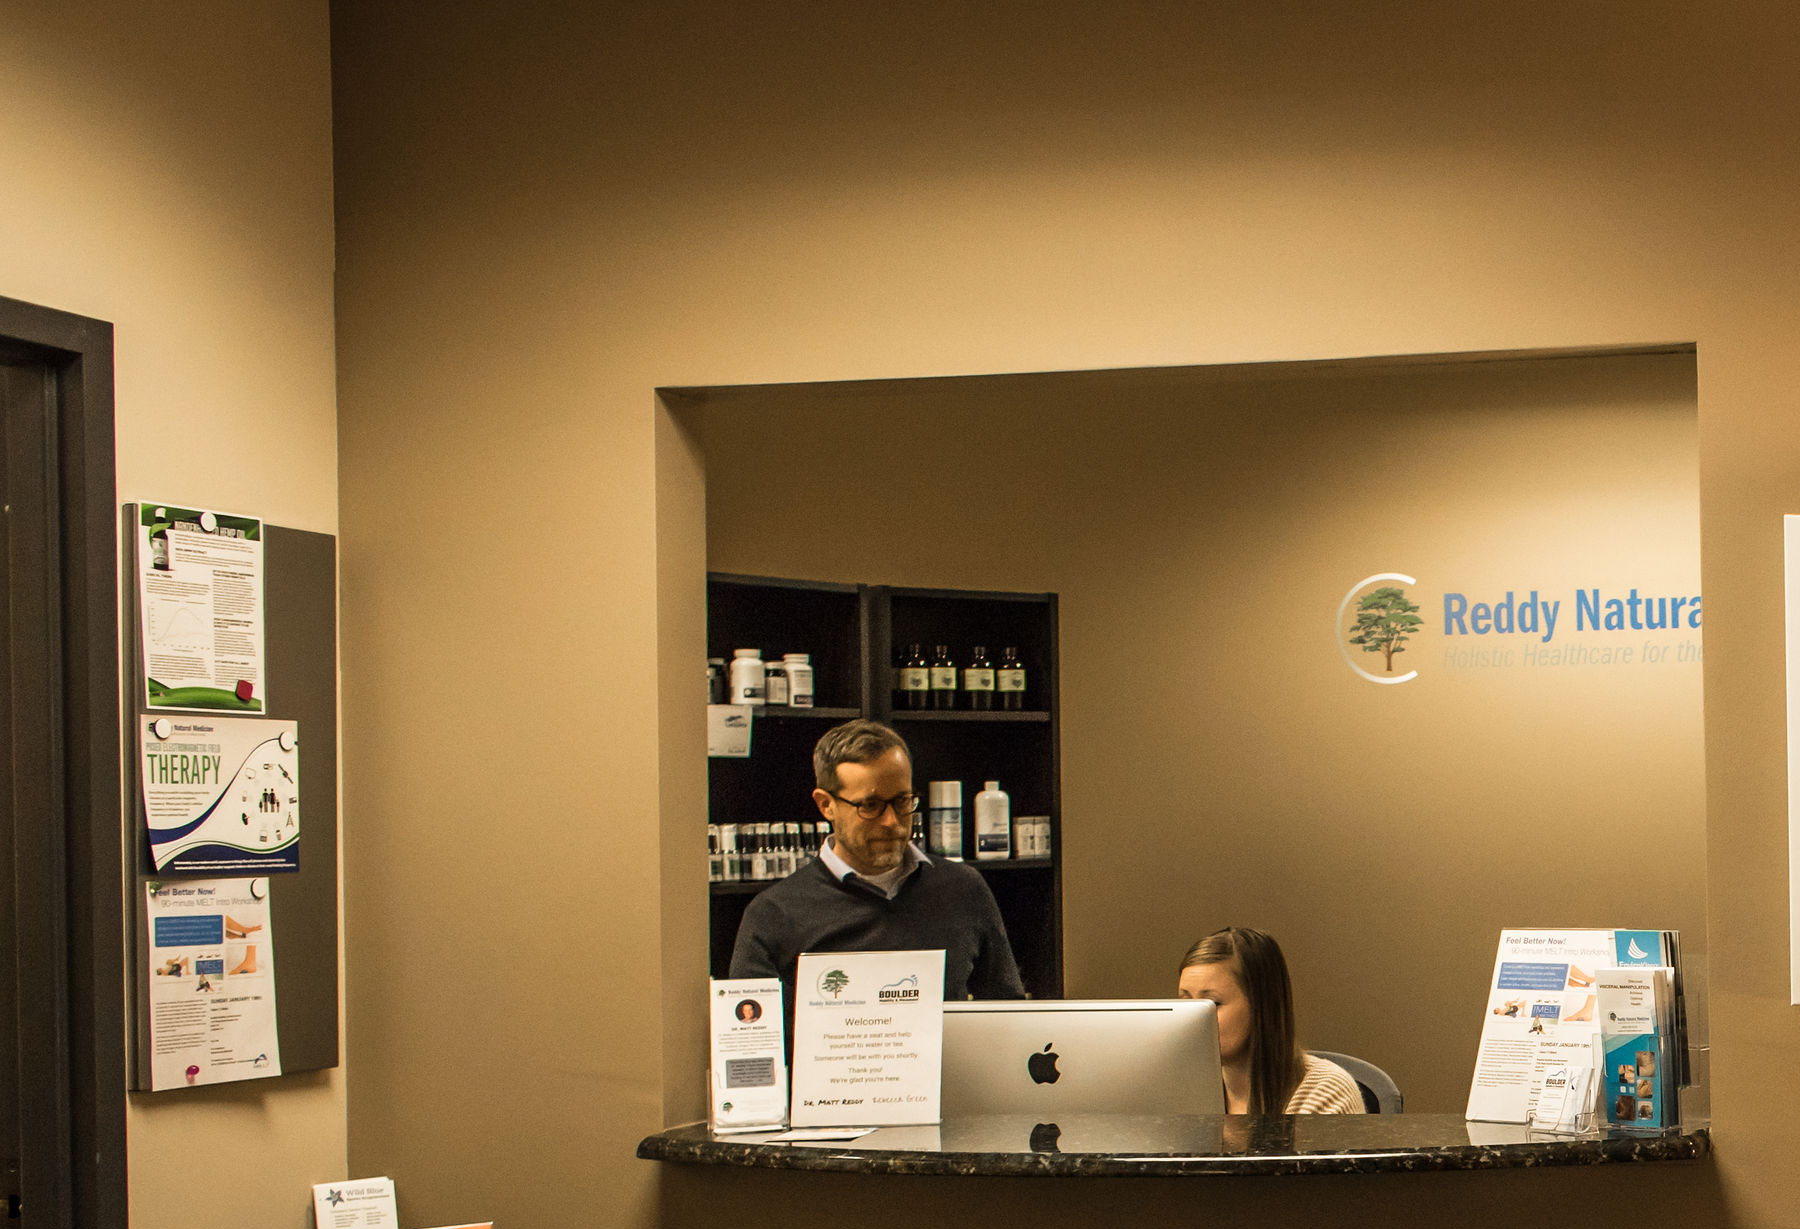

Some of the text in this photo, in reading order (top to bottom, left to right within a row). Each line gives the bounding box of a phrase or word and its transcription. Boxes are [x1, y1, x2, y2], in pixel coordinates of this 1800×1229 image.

[1442, 590, 1561, 643] Reddy
[1443, 646, 1514, 669] Holistic
[1522, 643, 1634, 666] Healthcare
[1641, 640, 1668, 662] for
[147, 754, 221, 785] THERAPY
[172, 887, 195, 896] Better
[197, 887, 216, 896] Now!
[1506, 936, 1568, 945] Feel Better Now!
[879, 989, 919, 998] BOULDER
[1533, 1004, 1559, 1014] MELT
[845, 1016, 892, 1026] Welcome!
[823, 1032, 845, 1040] Please
[898, 1031, 912, 1039] help
[829, 1041, 856, 1050] yourself
[814, 1054, 845, 1062] Someone
[883, 1053, 895, 1061] you
[849, 1076, 864, 1085] glad
[865, 1076, 884, 1084] you're
[818, 1098, 840, 1106] MATT
[842, 1098, 864, 1106] REDDY
[346, 1188, 365, 1196] Wild
